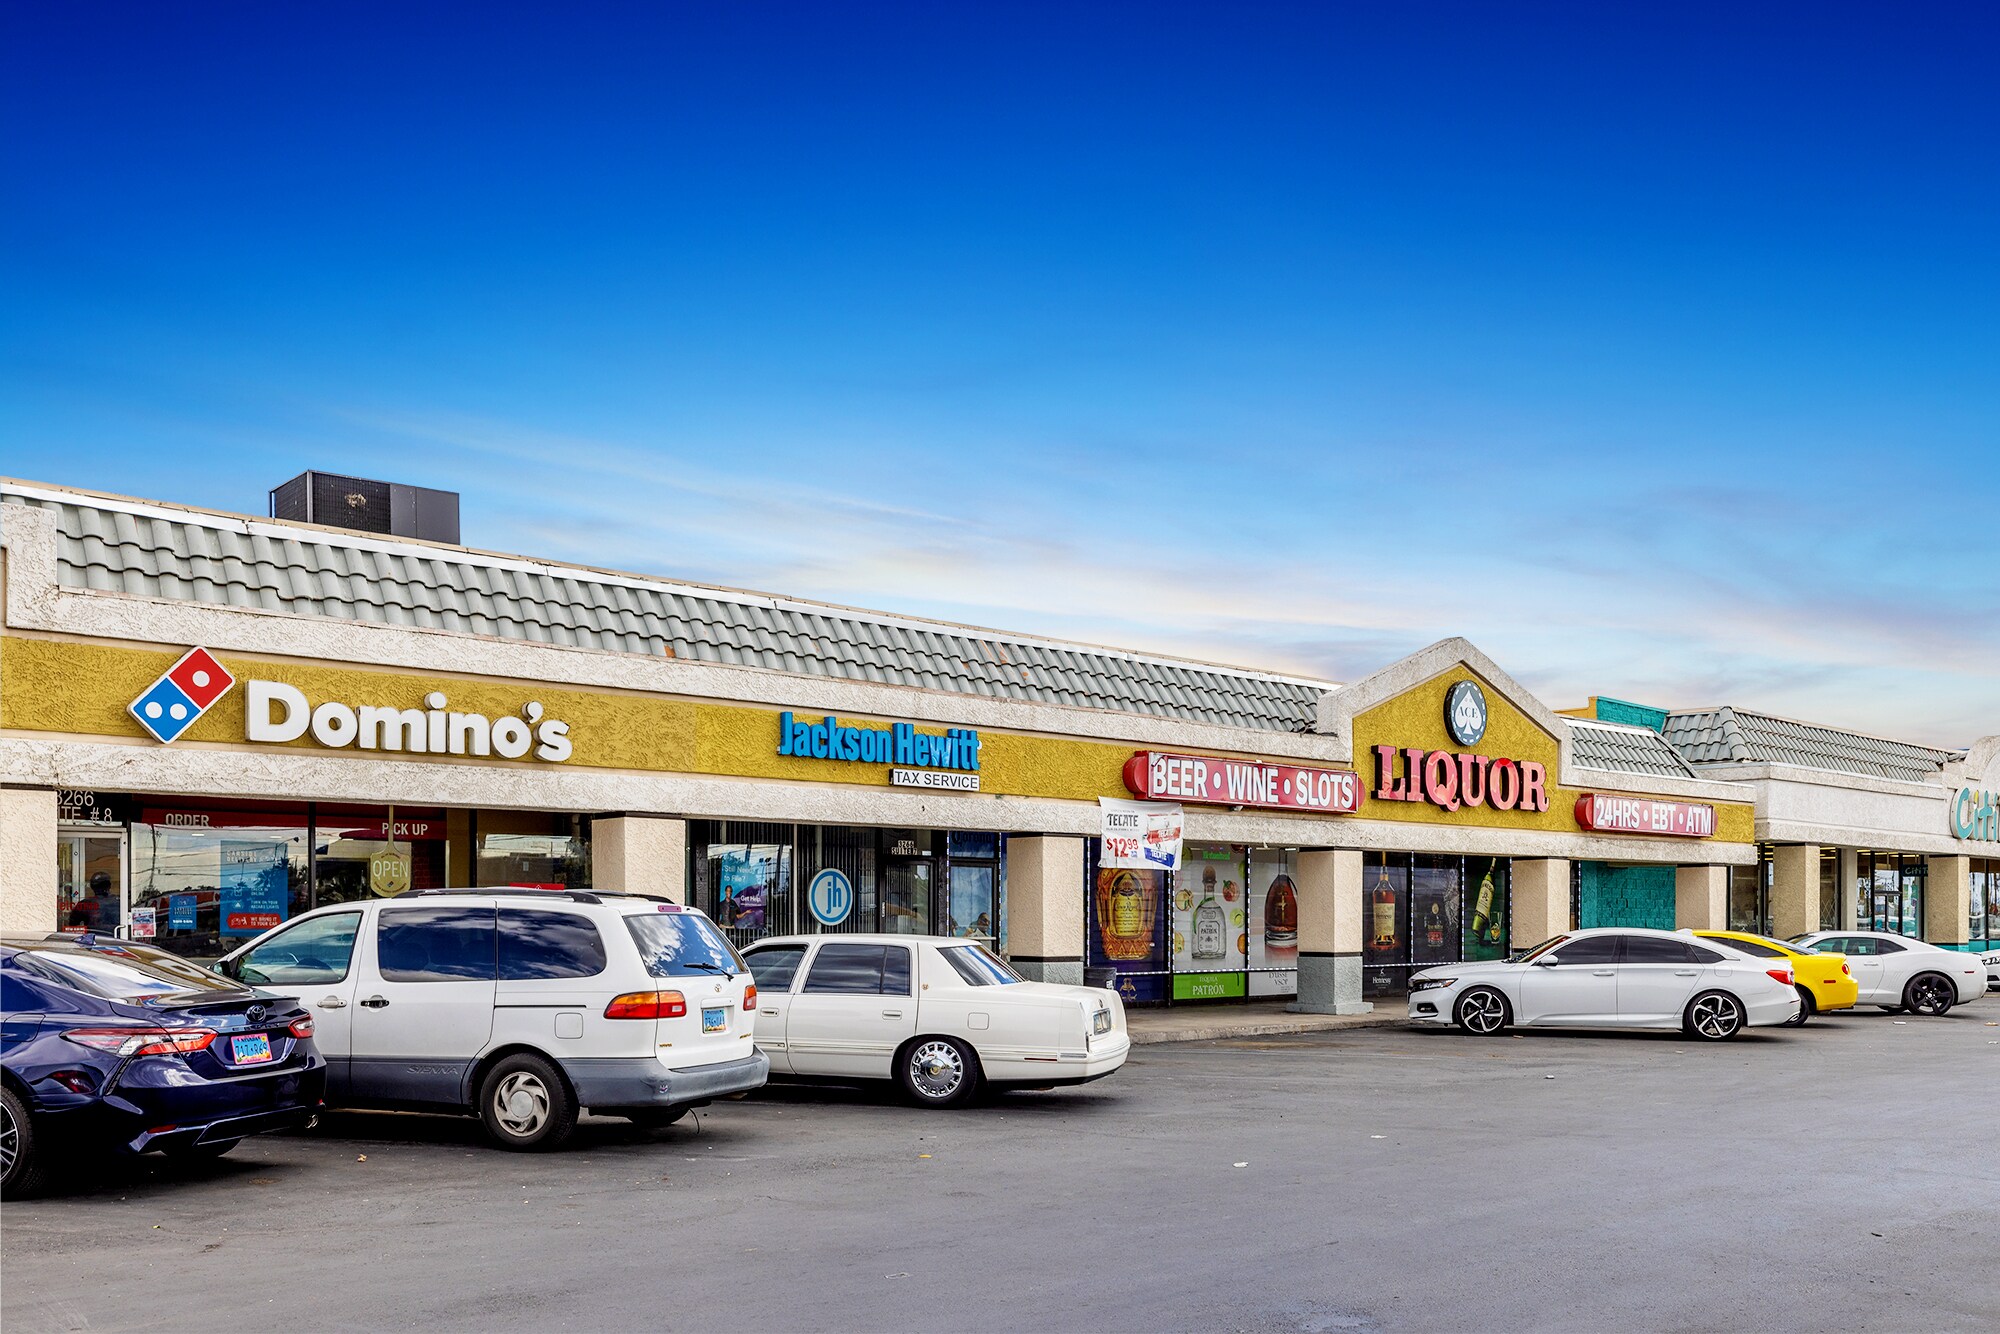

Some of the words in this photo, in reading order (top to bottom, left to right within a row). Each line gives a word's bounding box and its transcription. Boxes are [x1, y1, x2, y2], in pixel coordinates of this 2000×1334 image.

[245, 680, 573, 762] Domino's
[1458, 706, 1479, 718] ACE
[778, 711, 893, 764] Jackson
[892, 722, 980, 770] Hewitt
[894, 770, 920, 785] TAX
[923, 774, 978, 789] SERVICE
[1153, 757, 1209, 798] BEER
[1225, 763, 1279, 803] WINE
[1295, 769, 1354, 809] SLOTS
[1373, 744, 1550, 812] LIQUOR
[57, 805, 82, 823] ITE
[165, 813, 210, 827] ORDER
[1107, 813, 1139, 828] TECATE
[1595, 798, 1641, 829] 24HRS
[1651, 802, 1676, 831] EBT
[1685, 806, 1712, 834] ATM
[381, 822, 409, 835] PCK
[412, 823, 428, 836] UP
[372, 860, 409, 879] OPEN
[1904, 866, 1922, 875] Citi
